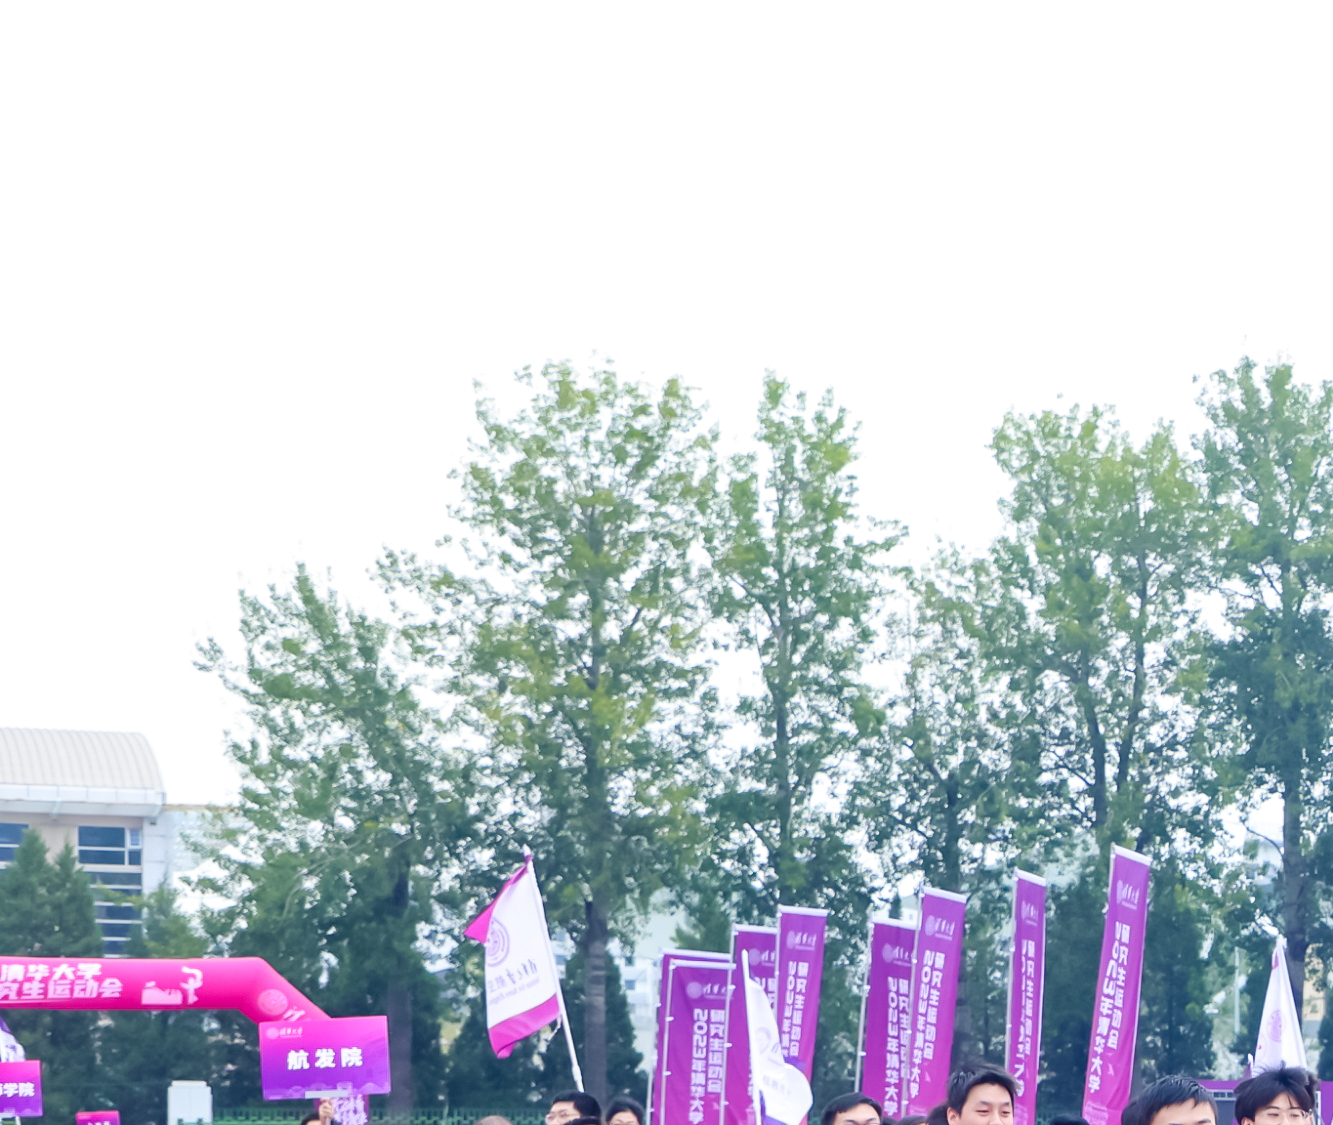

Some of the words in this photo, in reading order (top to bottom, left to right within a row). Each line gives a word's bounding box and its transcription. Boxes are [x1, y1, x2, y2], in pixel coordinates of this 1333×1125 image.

[0, 962, 102, 981] 清华大学
[286, 1046, 364, 1071] 航发院
[0, 1081, 36, 1097] 学院
